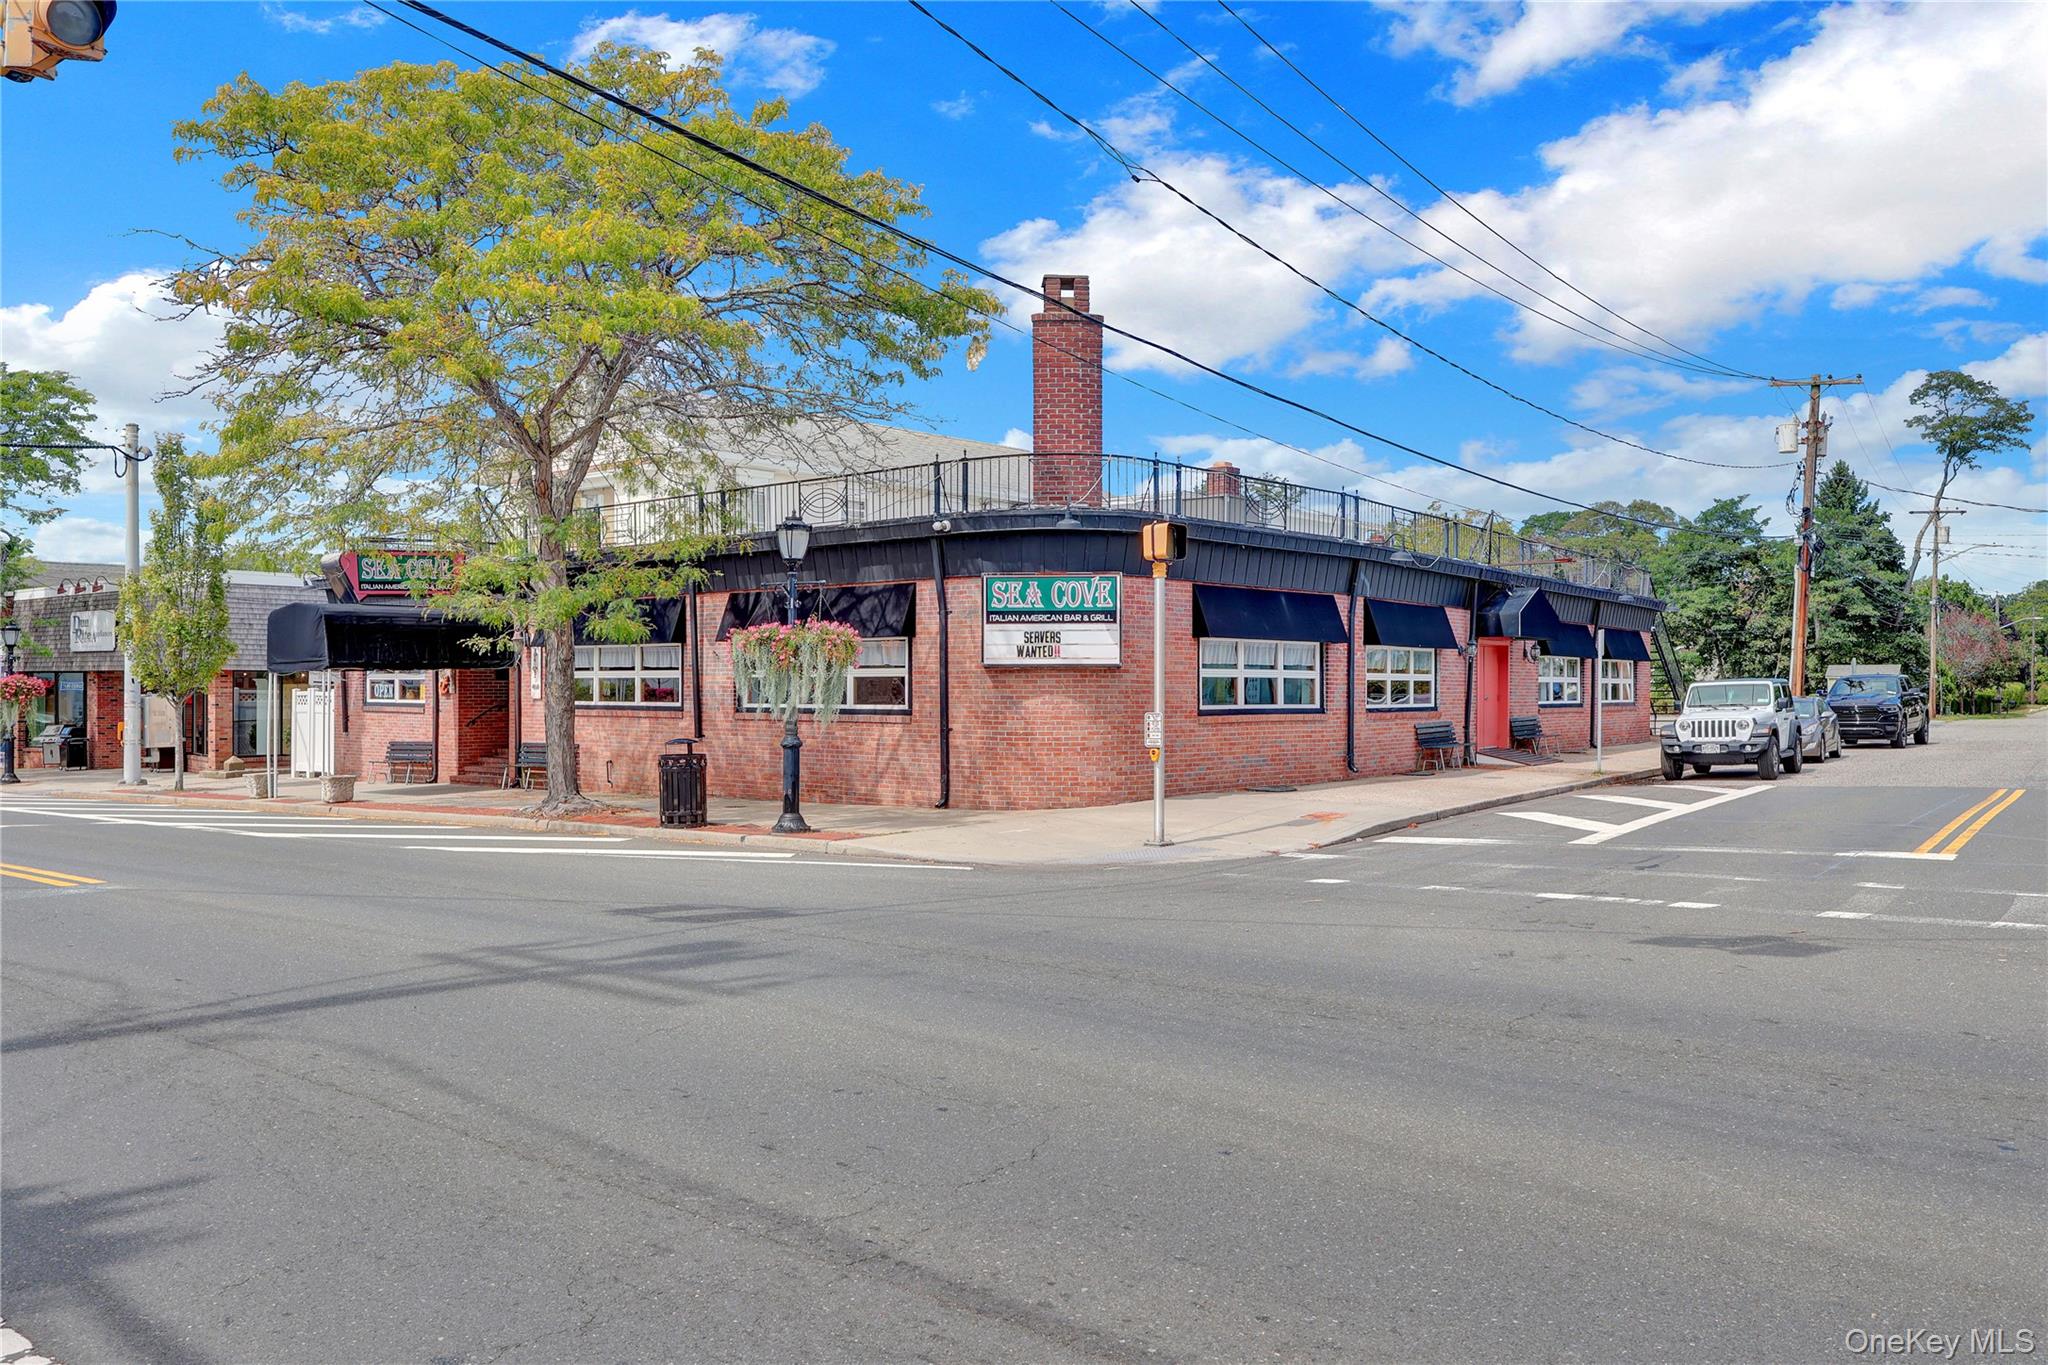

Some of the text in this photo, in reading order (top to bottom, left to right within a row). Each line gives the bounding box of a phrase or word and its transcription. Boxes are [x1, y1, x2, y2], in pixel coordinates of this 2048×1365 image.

[361, 557, 401, 579] SEA
[991, 577, 1113, 608] SEA COVE
[989, 614, 1019, 622] ITALIAN
[1020, 614, 1062, 622] AMERICAN
[1064, 614, 1082, 622] BAR
[1091, 614, 1113, 622] GRILL
[1024, 631, 1061, 644] SERVERS
[1016, 645, 1060, 658] WANTED!!
[374, 683, 394, 698] OPEN
